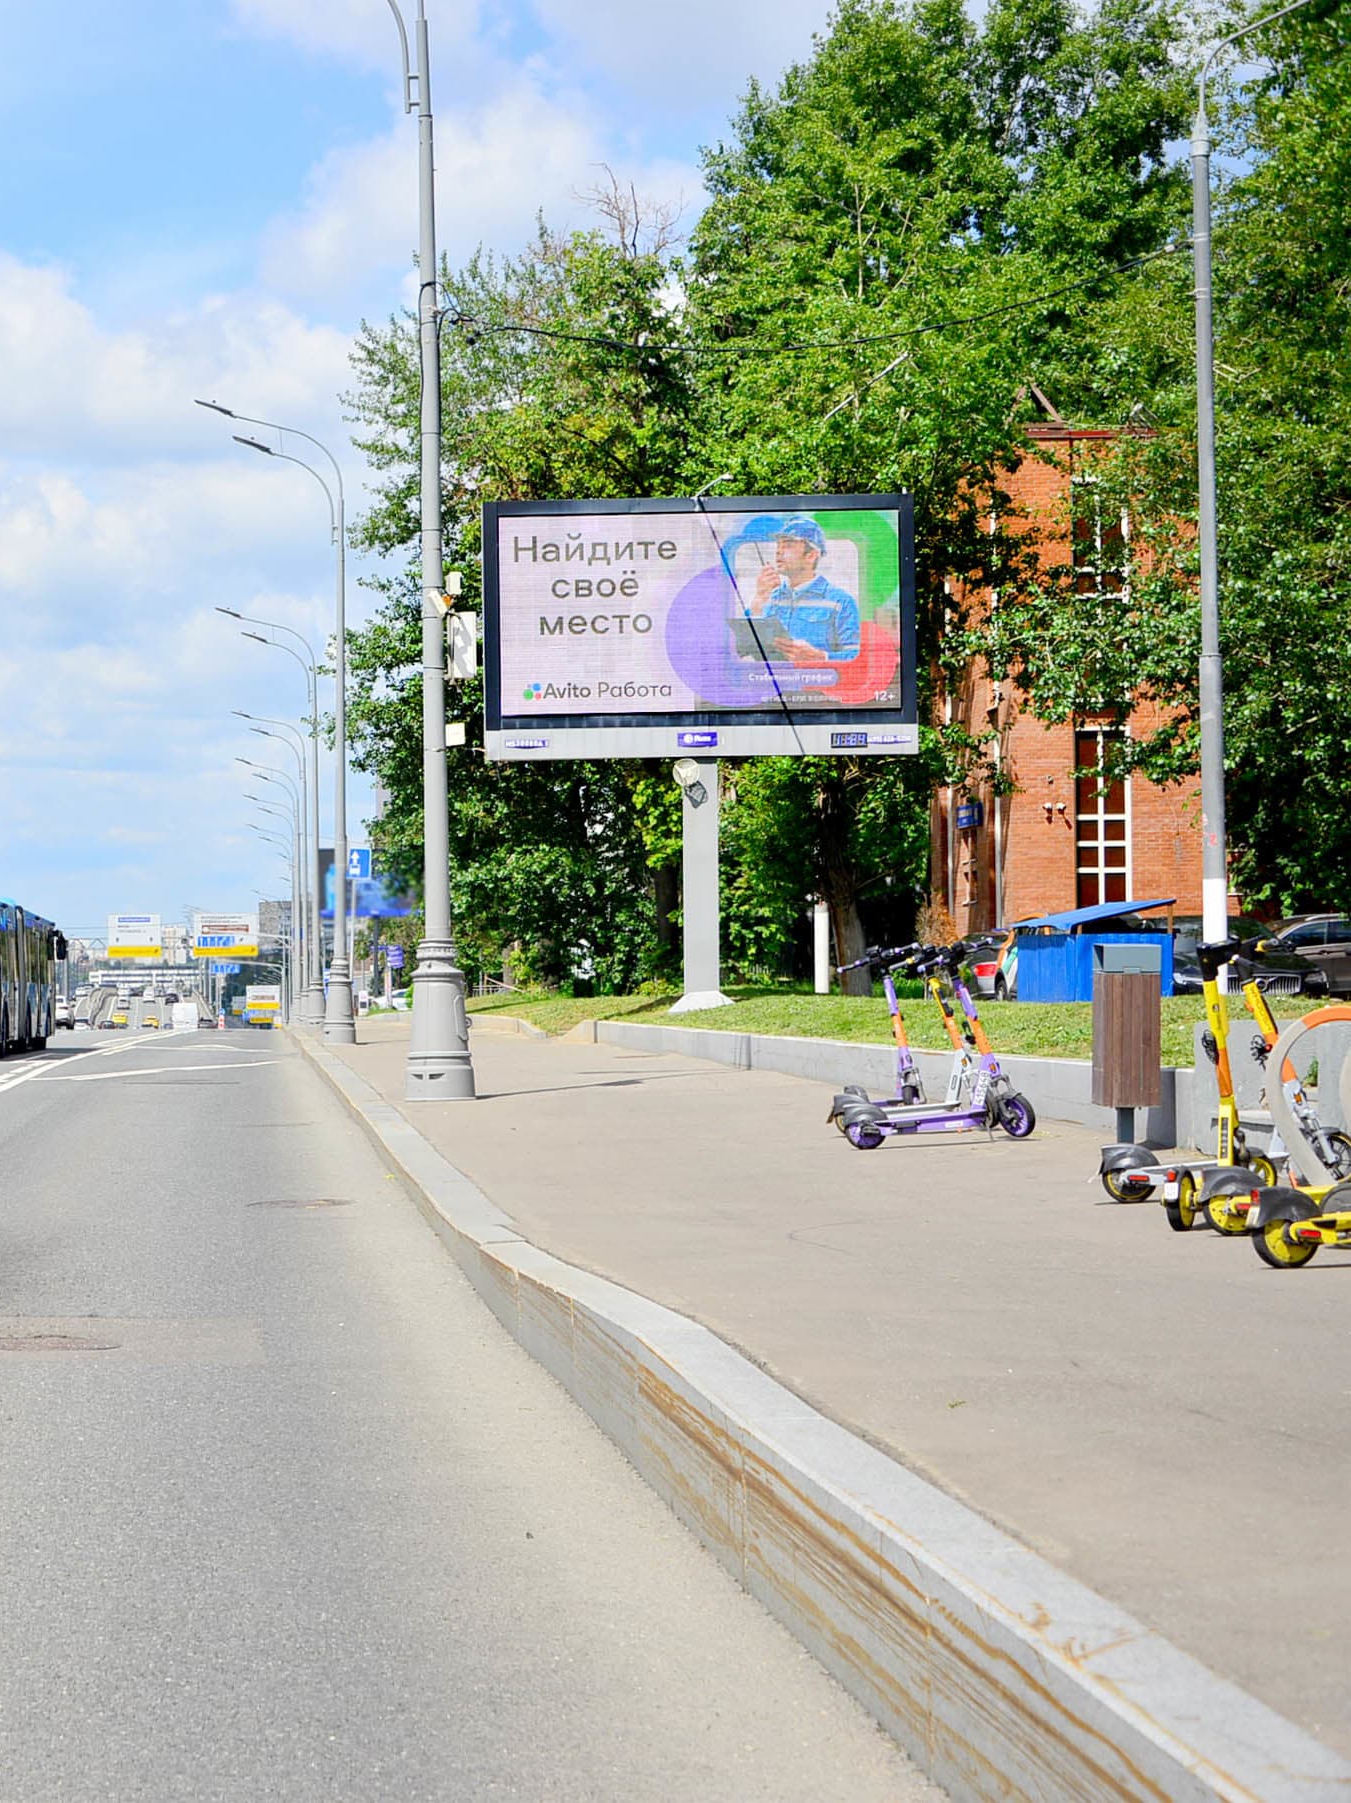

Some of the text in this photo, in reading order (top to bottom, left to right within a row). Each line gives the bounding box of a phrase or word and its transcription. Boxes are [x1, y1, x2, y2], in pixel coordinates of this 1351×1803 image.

[513, 533, 678, 566] Найдите
[551, 570, 639, 599] своё
[539, 613, 653, 636] место
[543, 681, 672, 699] Avito Работа
[873, 690, 896, 701] 12+
